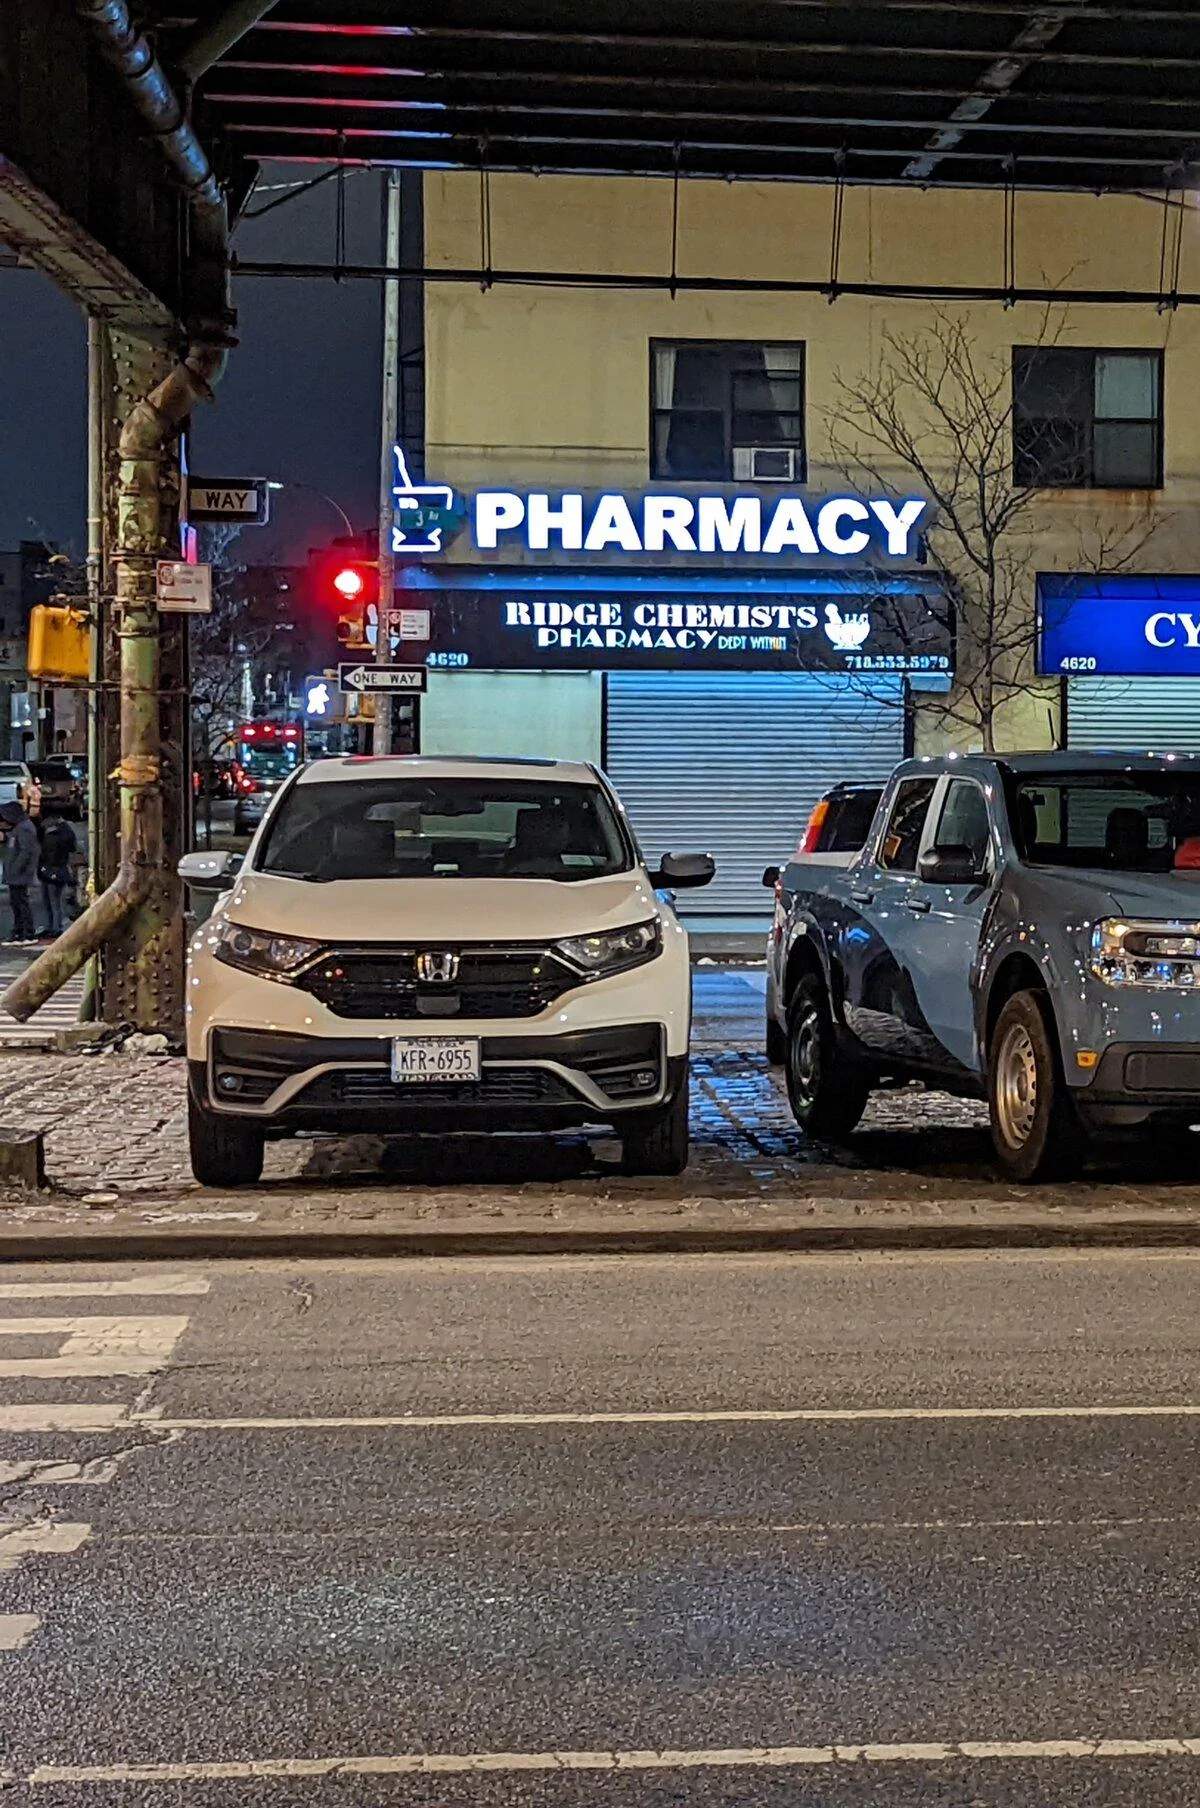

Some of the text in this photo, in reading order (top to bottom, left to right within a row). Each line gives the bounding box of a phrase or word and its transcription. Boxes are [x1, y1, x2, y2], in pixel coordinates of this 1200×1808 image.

[205, 491, 248, 509] WAY
[475, 492, 927, 555] PHARMACY
[505, 602, 818, 629] RIDGE CHEMISTS
[538, 627, 718, 649] PHARMACY
[718, 635, 747, 650] DEPT
[426, 652, 469, 666] 4620
[1060, 657, 1097, 670] 4620
[353, 672, 416, 684] ONE WAY
